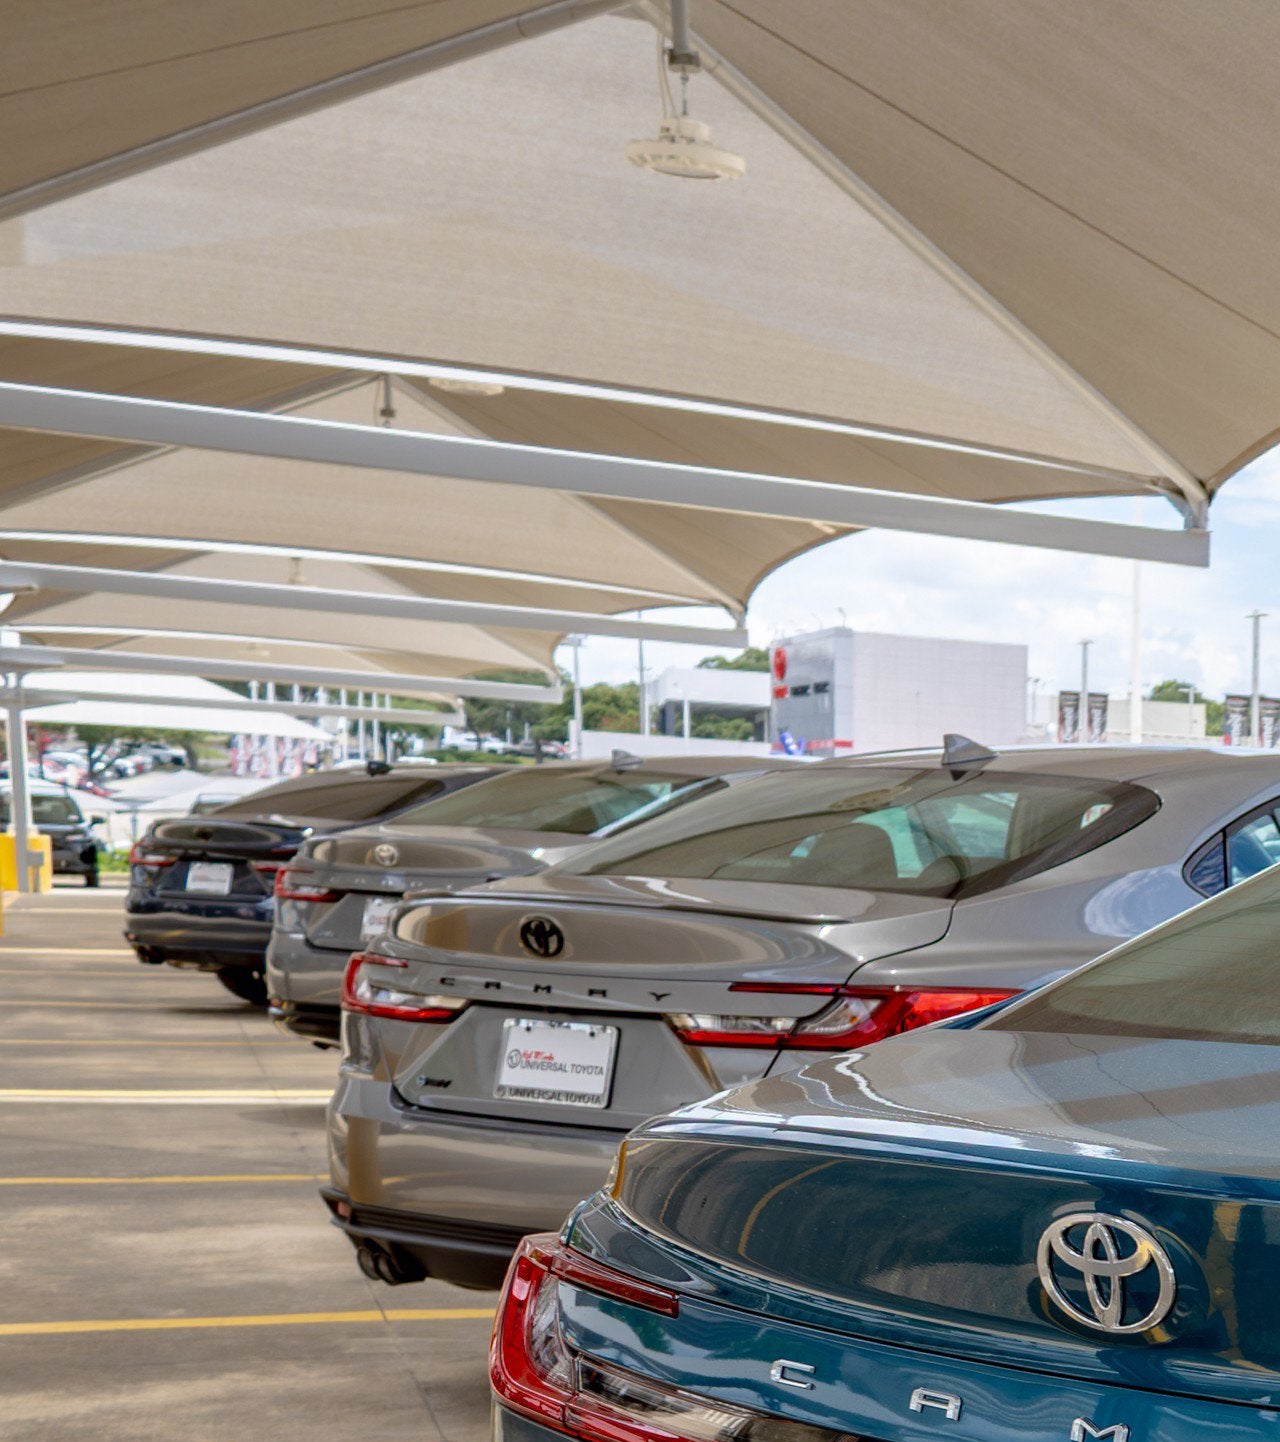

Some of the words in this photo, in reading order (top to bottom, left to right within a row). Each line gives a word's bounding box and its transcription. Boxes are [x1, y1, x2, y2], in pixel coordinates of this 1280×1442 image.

[520, 1060, 568, 1073] UNIVERSAL
[570, 1063, 604, 1076] TOYOTA
[509, 1087, 560, 1101] UNIVERSAL
[564, 1094, 601, 1104] TOYOTA
